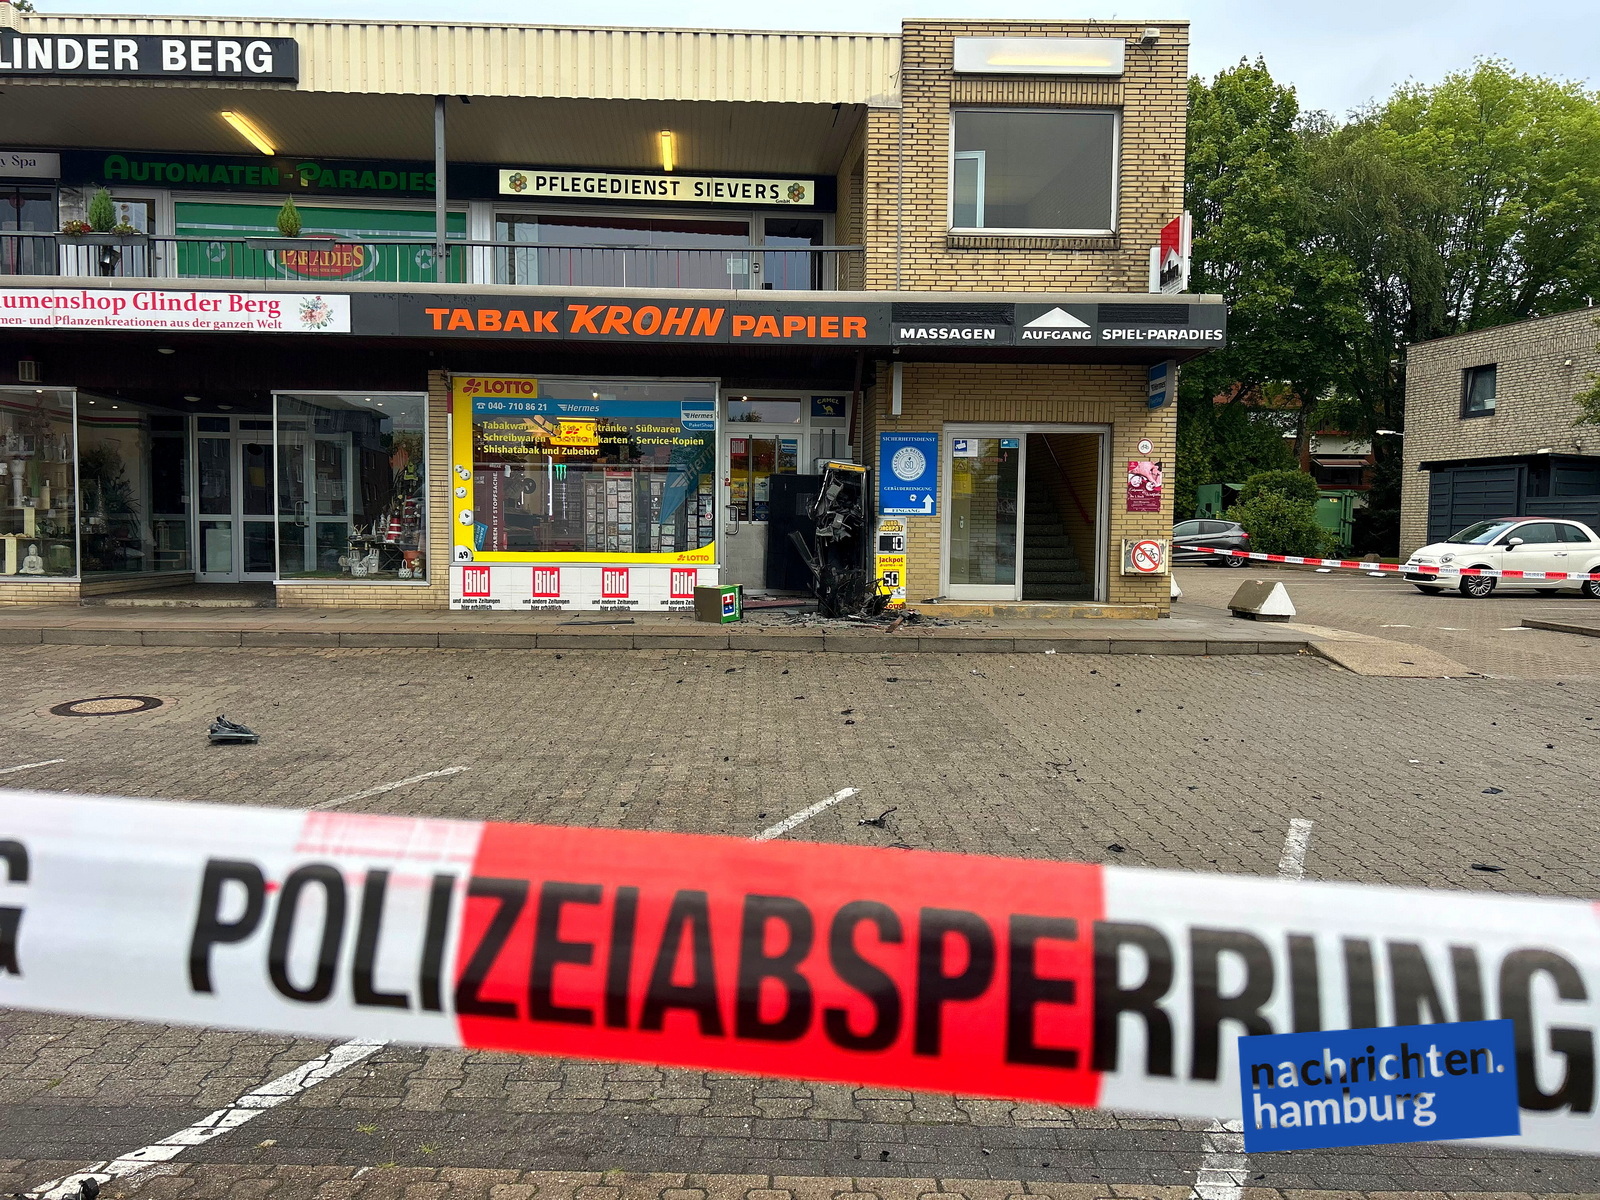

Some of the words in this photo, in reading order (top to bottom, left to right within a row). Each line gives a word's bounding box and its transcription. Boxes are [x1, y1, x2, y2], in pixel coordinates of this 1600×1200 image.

[162, 39, 273, 73] BERG
[11, 155, 36, 169] Spa
[535, 175, 680, 196] PFLEGEDIENST
[694, 181, 780, 199] SIEVERS
[0, 291, 126, 316] umenshop
[132, 291, 221, 312] Glinder
[228, 294, 281, 319] Berg
[29, 315, 51, 325] und
[55, 315, 167, 327] Pflanzenkreationen
[192, 318, 211, 328] der
[213, 320, 254, 331] ganzen
[257, 319, 282, 329] Welt
[425, 308, 558, 333] TABAK
[566, 304, 724, 337] KROHN
[732, 315, 867, 340] PAPIER
[900, 328, 996, 340] MASSAGEN
[1022, 330, 1092, 340] AUFGANG
[1102, 328, 1223, 341] SPIEL-PARADIES
[484, 380, 534, 394] LOTTO
[487, 402, 506, 411] 040-
[508, 403, 524, 411] 710
[525, 403, 536, 412] 86
[537, 404, 547, 412] 21
[567, 404, 600, 412] Hermes
[636, 424, 681, 433] Süßwaren
[483, 432, 546, 442] Schreibwaren
[636, 436, 704, 447] Service-Kopien
[483, 445, 540, 454] Shishatabak
[562, 446, 600, 455] Zubehör
[458, 551, 469, 560] 49
[464, 569, 489, 593] Bild
[534, 570, 558, 594] Bild
[603, 571, 627, 594] Bild
[884, 572, 899, 586] 50
[187, 857, 1597, 1114] POLIZEIABSPERRUNG
